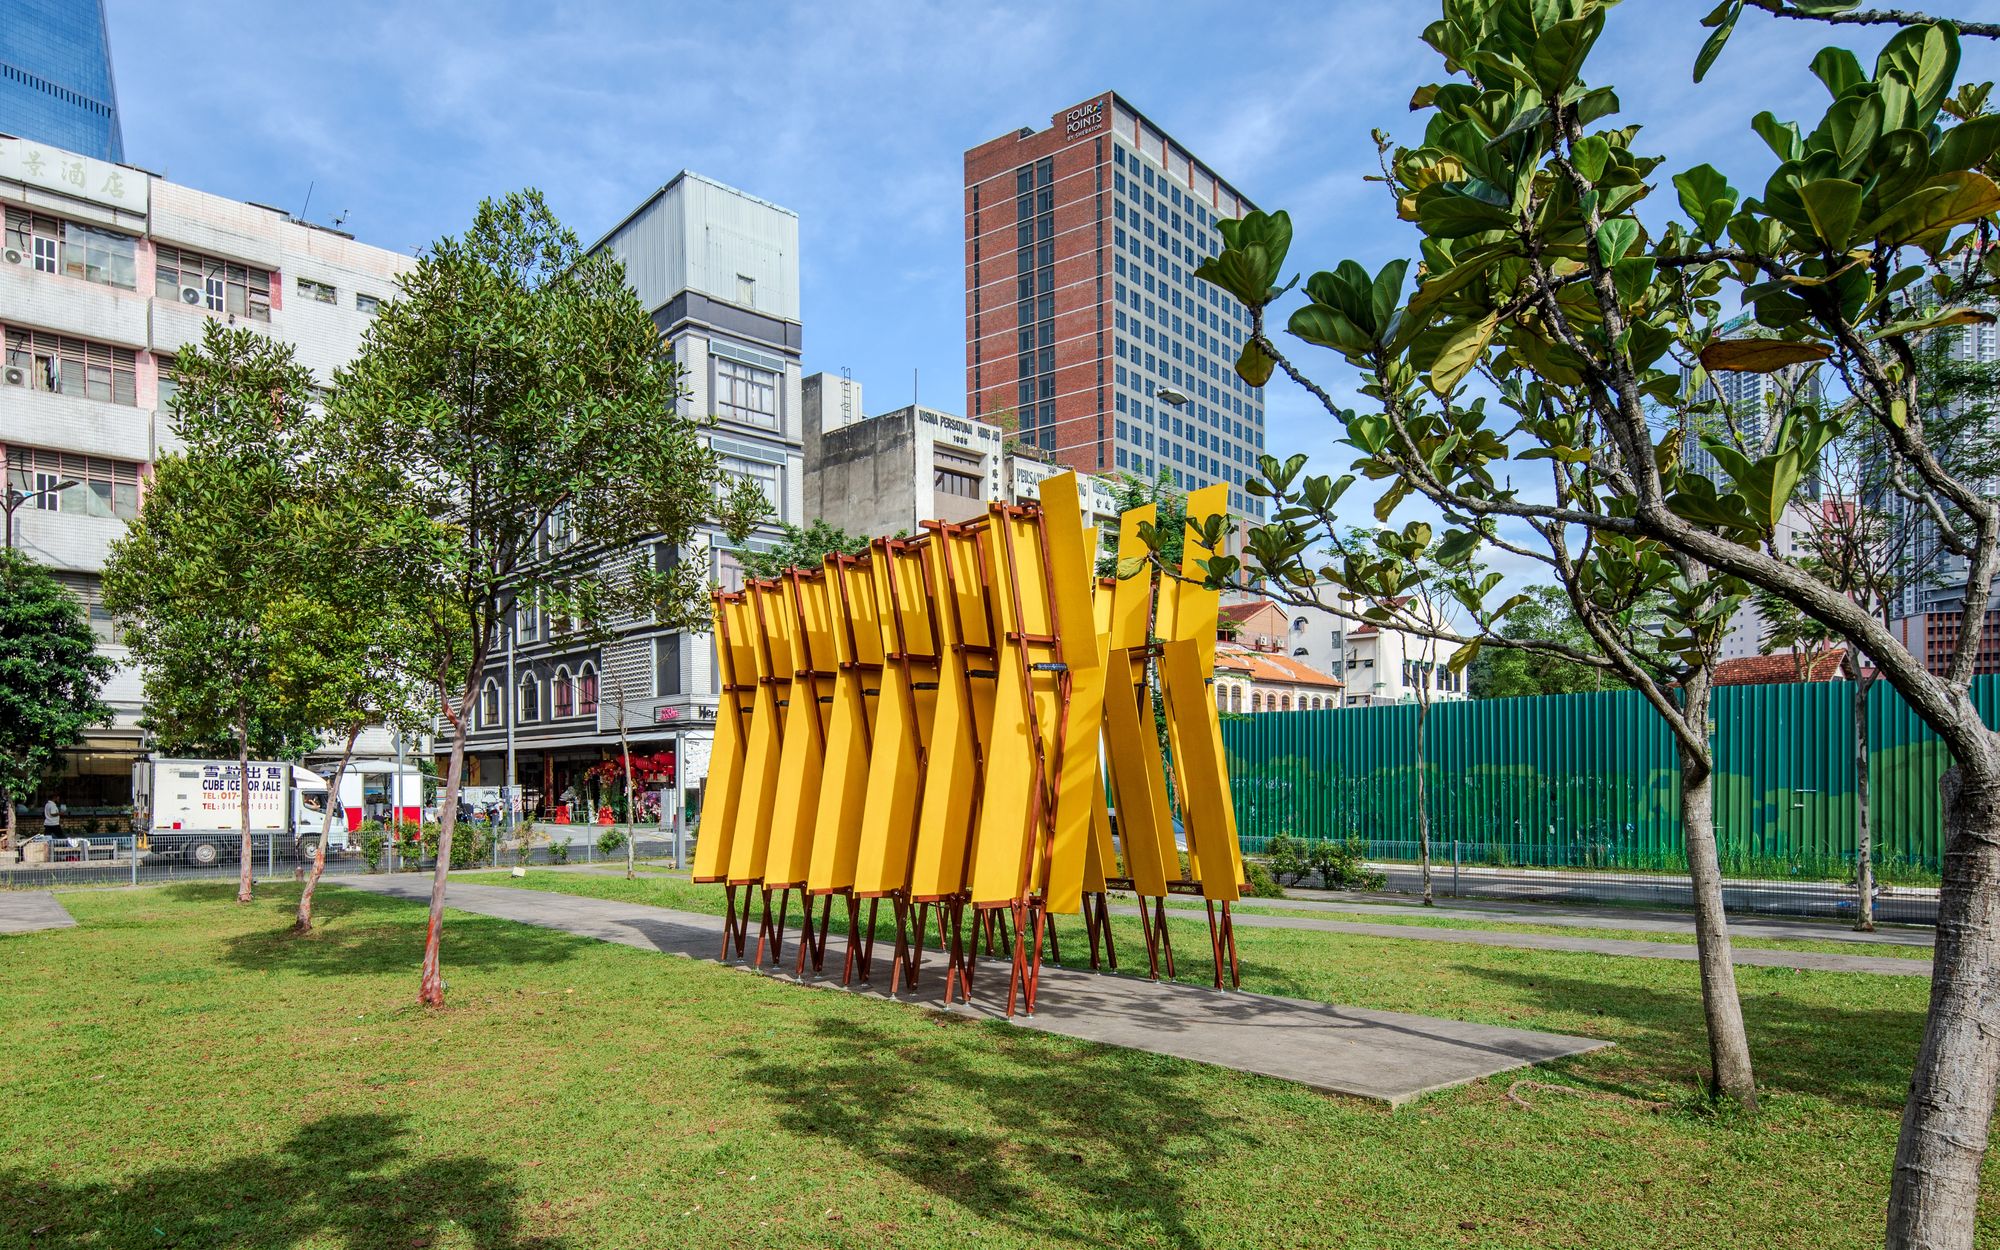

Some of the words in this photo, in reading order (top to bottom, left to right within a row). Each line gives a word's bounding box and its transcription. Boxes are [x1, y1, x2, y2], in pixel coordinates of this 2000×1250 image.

[1067, 104, 1092, 122] FOUR
[1067, 111, 1102, 133] POINTS
[0, 143, 125, 198] 景酒店
[918, 409, 938, 426] WISMA
[203, 780, 224, 790] CUBE
[227, 780, 241, 791] ICE
[247, 780, 260, 791] OR
[263, 781, 280, 791] SALE
